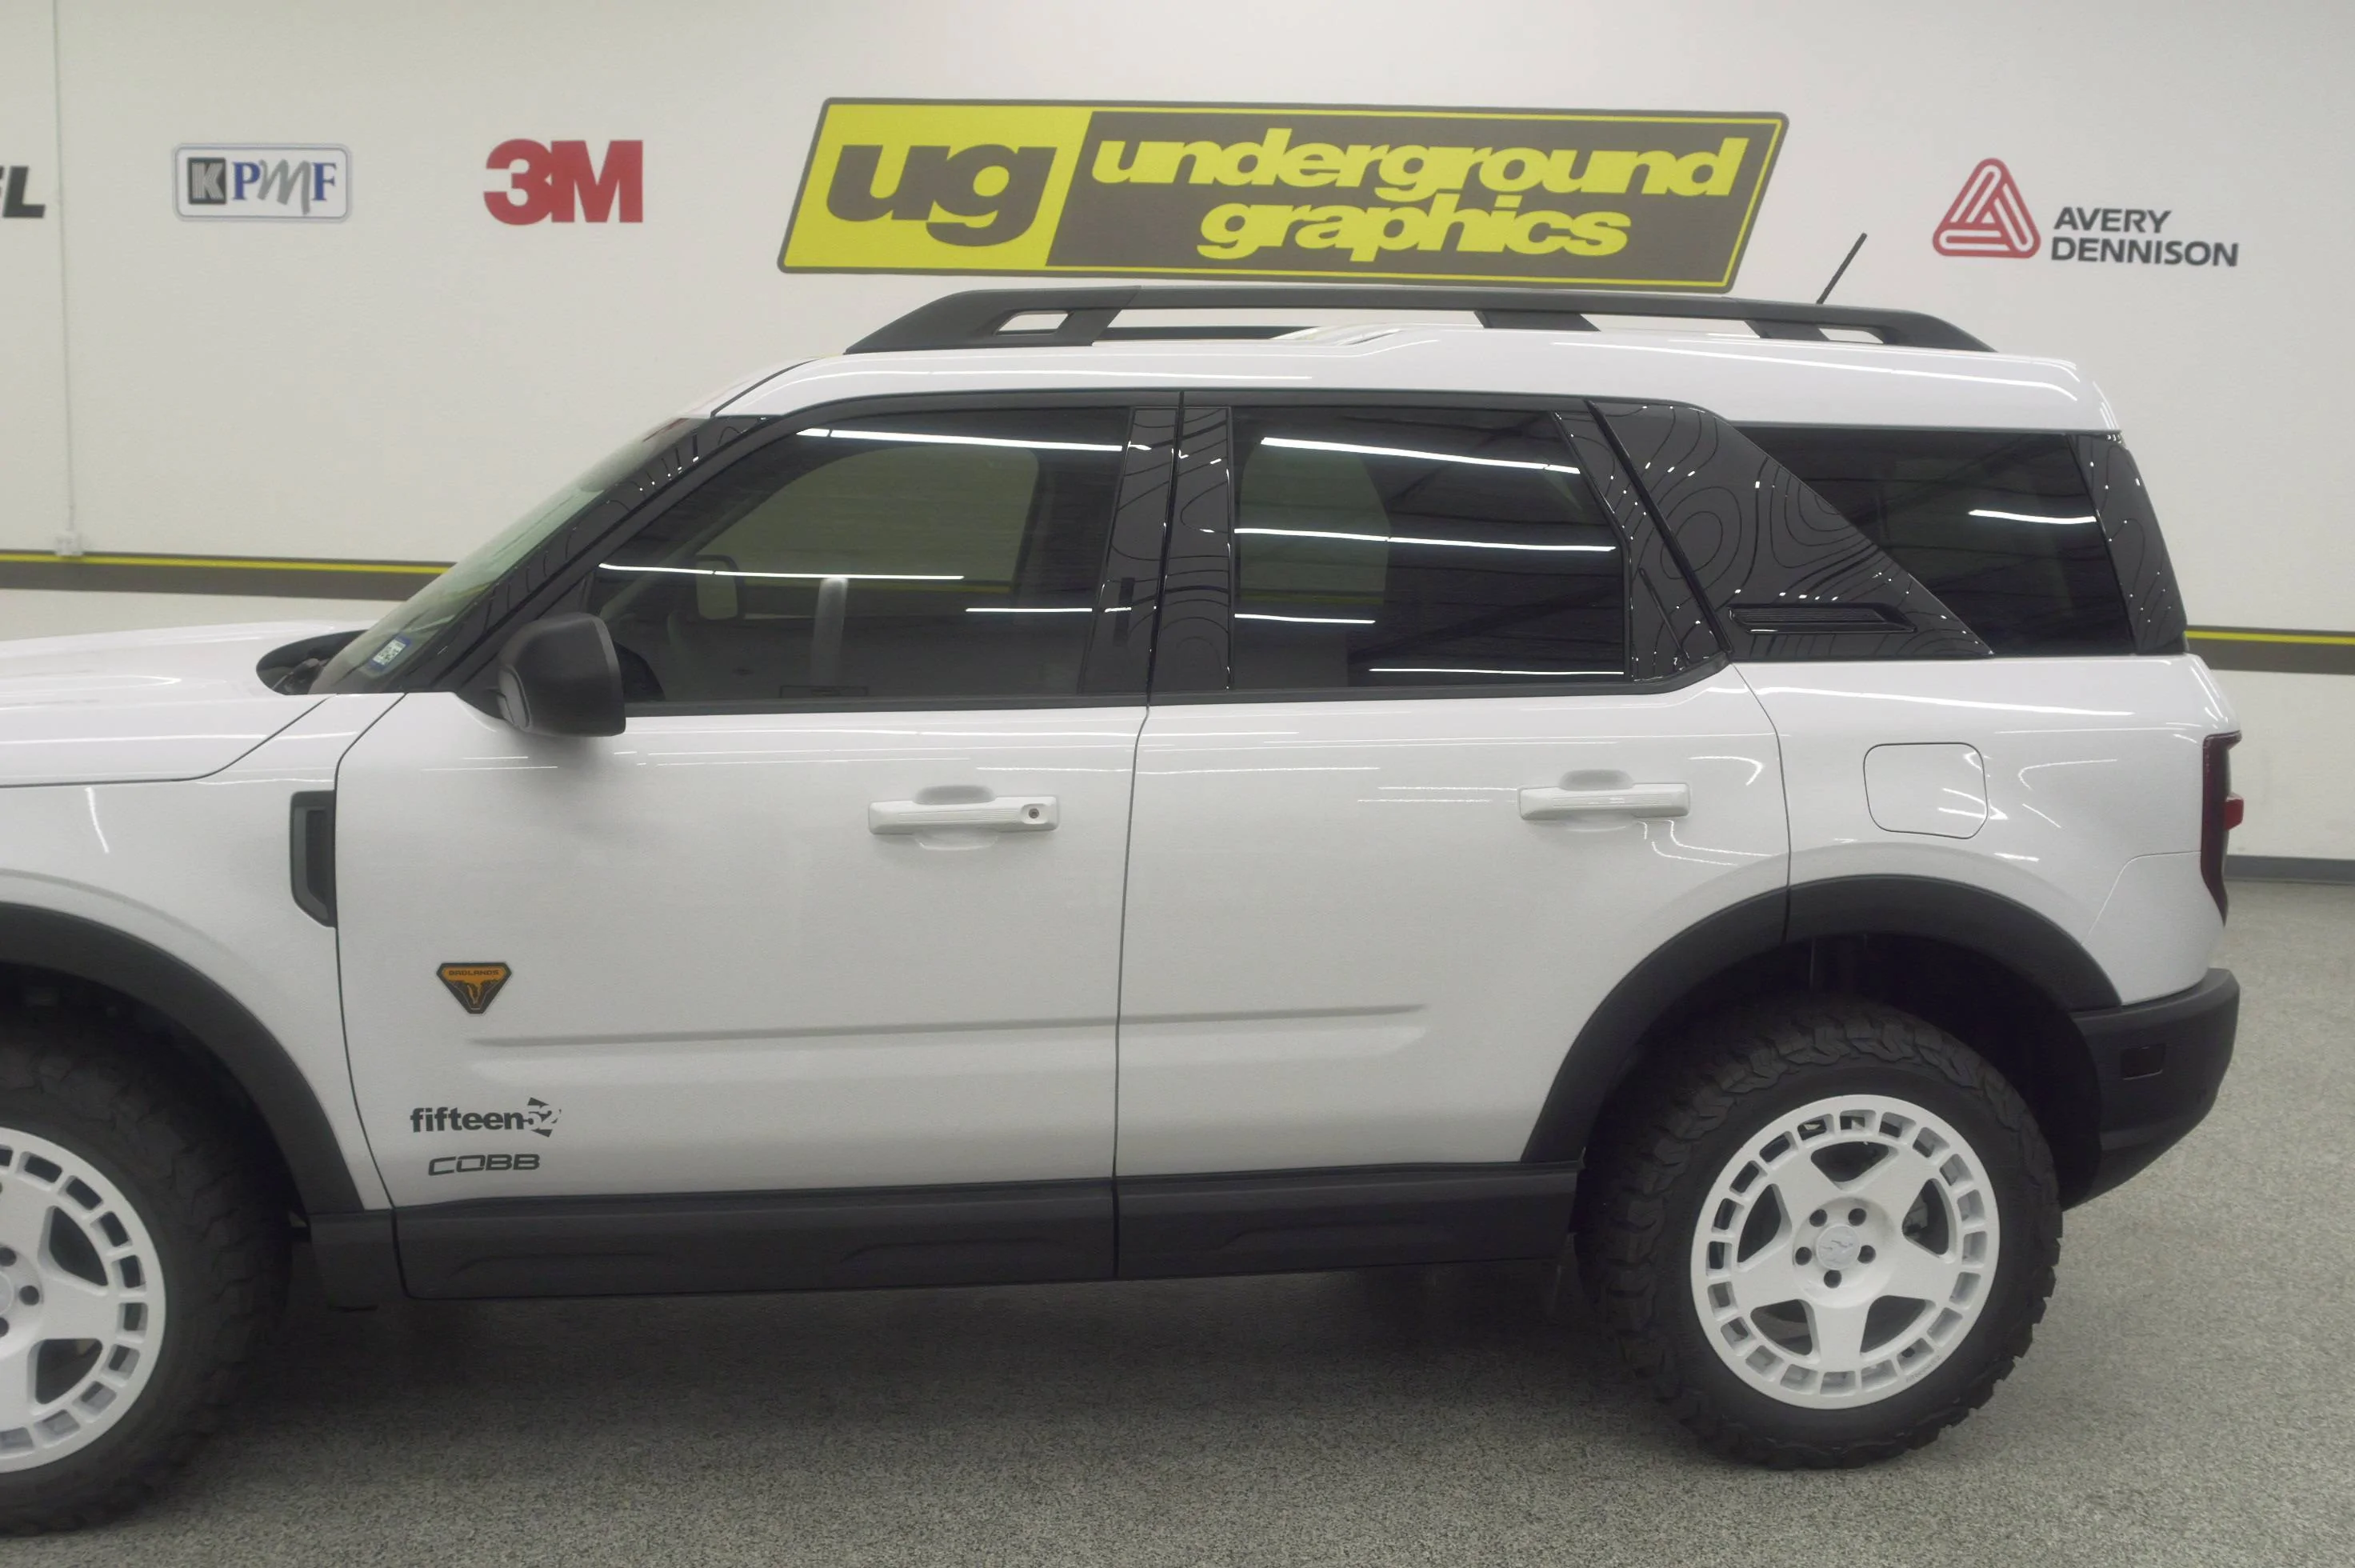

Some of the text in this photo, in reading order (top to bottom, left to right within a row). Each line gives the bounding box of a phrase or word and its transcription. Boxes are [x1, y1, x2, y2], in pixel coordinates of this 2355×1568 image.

[188, 157, 338, 215] KPMF
[485, 139, 643, 226] 3M
[826, 143, 1057, 246] ug
[1090, 126, 1750, 203] underground
[1197, 193, 1631, 262] graphics
[2051, 236, 2239, 267] DENNISON
[2053, 206, 2171, 234] AVERY
[428, 1154, 541, 1176] COBB
